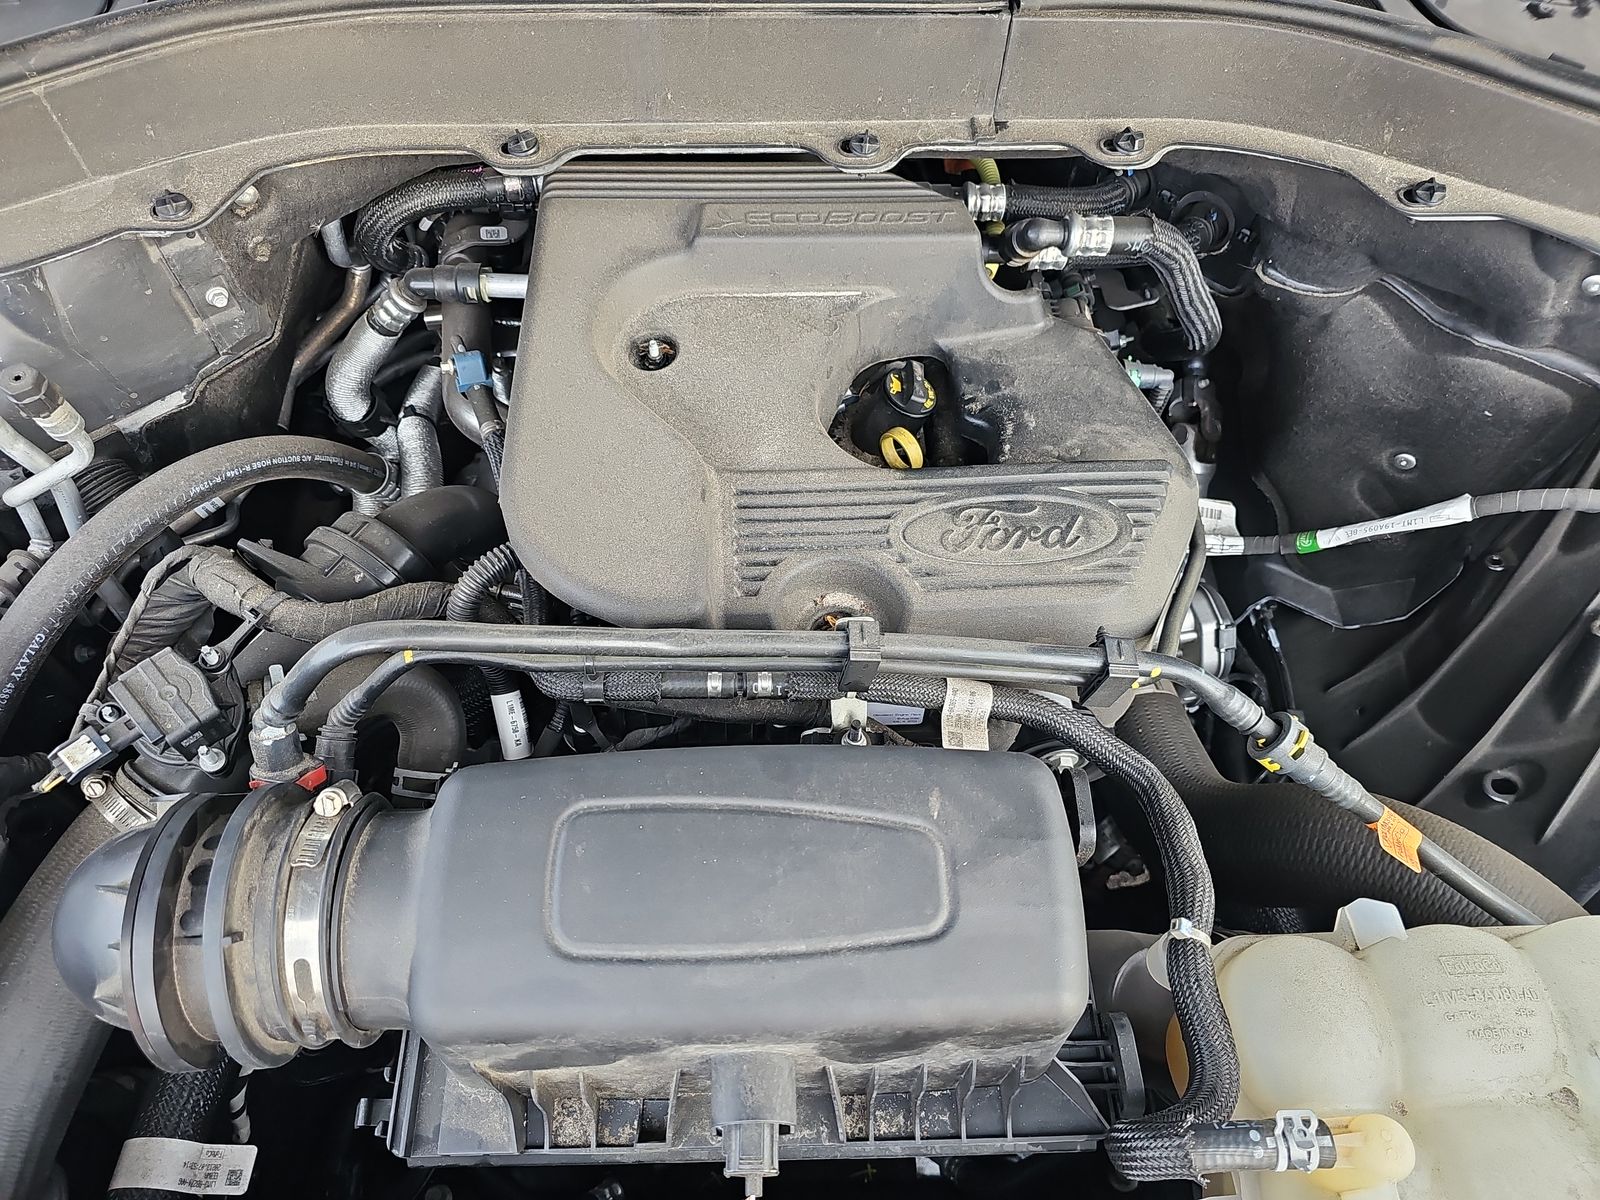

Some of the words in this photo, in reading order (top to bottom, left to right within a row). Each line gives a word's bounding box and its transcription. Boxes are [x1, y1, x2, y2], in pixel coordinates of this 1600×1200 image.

[251, 458, 272, 470] HOSE
[272, 454, 301, 466] SUCTION
[301, 454, 312, 463] A/C
[940, 503, 1084, 554] Ford
[10, 633, 46, 681] GALAXY
